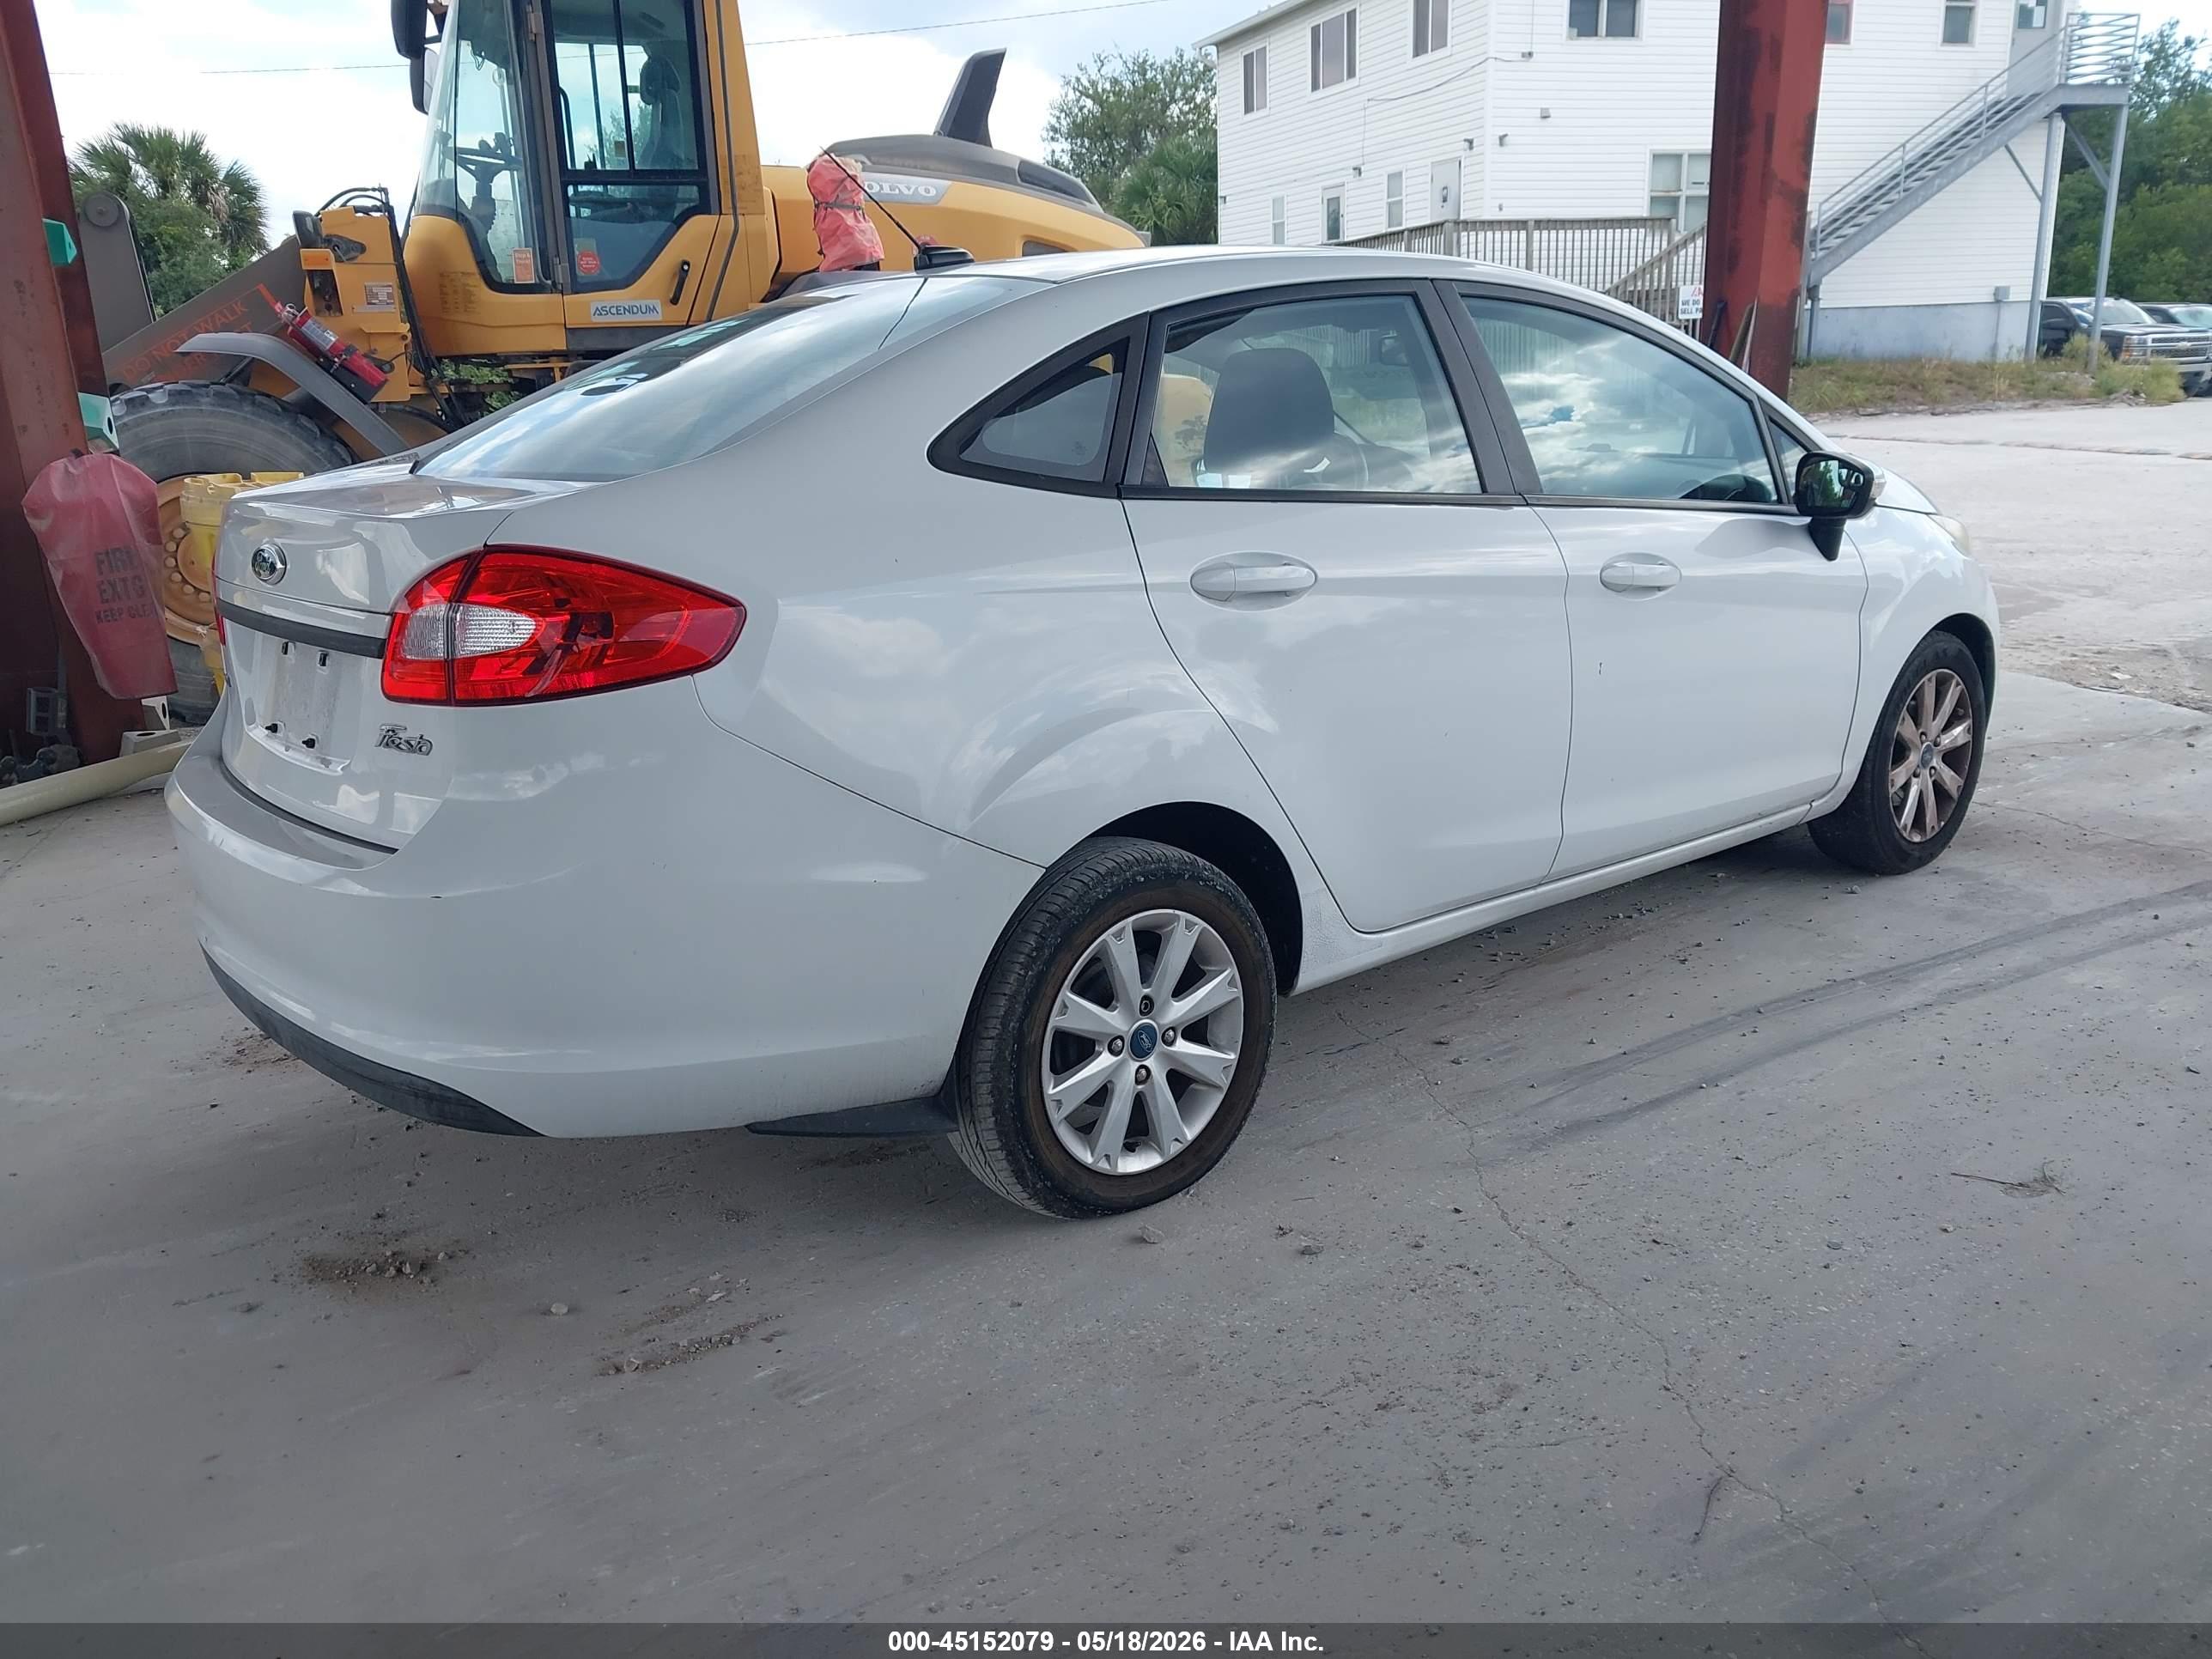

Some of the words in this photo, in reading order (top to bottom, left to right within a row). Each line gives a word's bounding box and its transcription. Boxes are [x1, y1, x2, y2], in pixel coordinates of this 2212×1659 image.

[864, 181, 936, 197] OLVO
[592, 305, 659, 317] ASCENDUM
[123, 356, 152, 382] DO
[155, 328, 191, 358] NOT
[193, 301, 248, 333] WALK
[95, 606, 124, 624] KEEP
[374, 723, 433, 756] Fiesta
